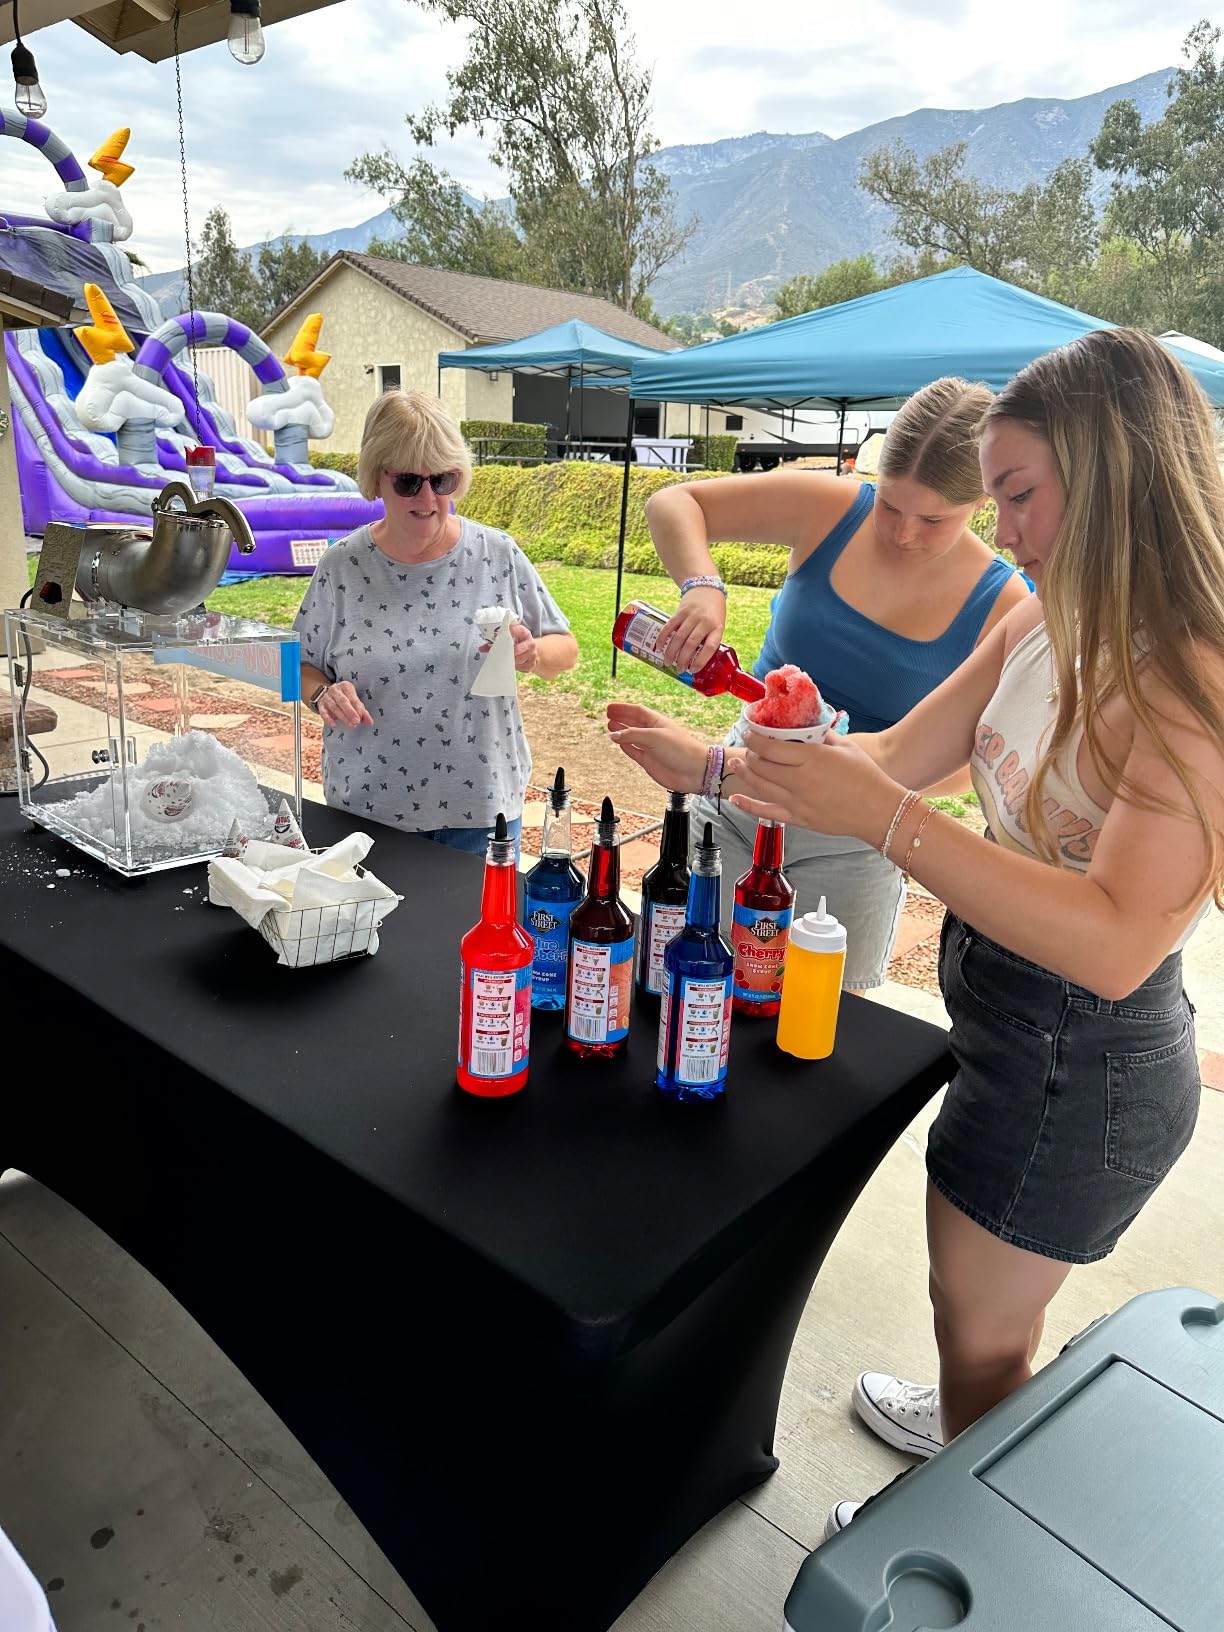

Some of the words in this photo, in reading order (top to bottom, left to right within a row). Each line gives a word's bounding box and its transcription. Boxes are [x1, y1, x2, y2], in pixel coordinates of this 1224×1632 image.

[533, 910, 555, 922] FIRST
[530, 917, 557, 930] STREET
[755, 919, 777, 930] FIRST
[751, 927, 779, 937] STREET
[532, 934, 559, 951] lue
[737, 943, 787, 962] Cherry
